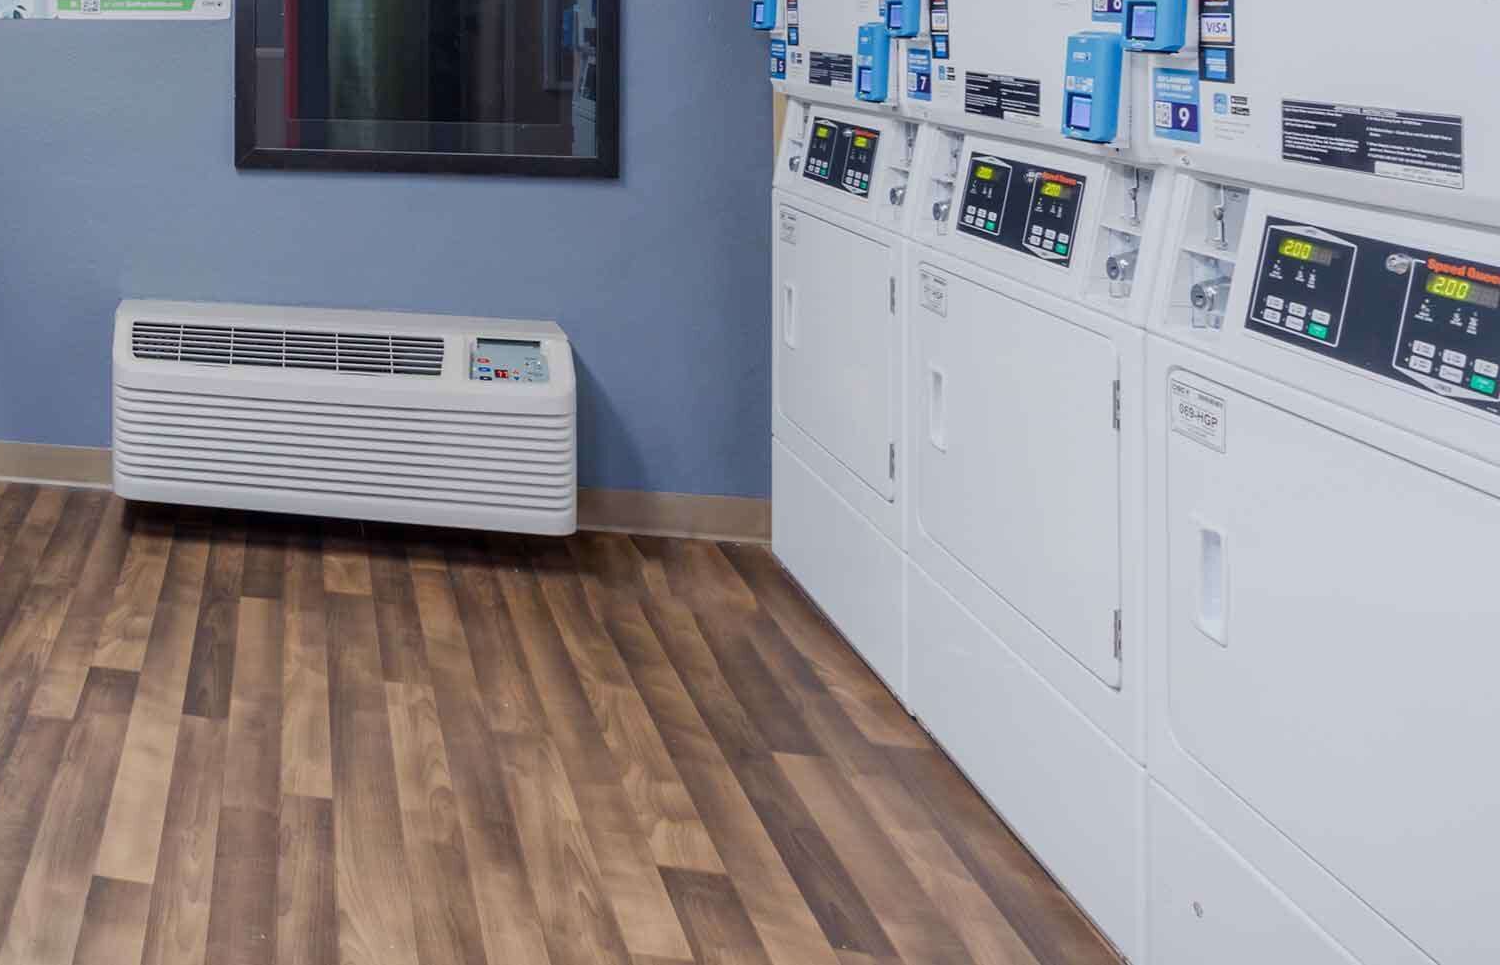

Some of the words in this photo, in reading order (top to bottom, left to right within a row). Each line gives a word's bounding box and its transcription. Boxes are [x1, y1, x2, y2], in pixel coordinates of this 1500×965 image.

[1205, 21, 1228, 33] VISA
[919, 76, 927, 90] 7
[1178, 108, 1190, 127] 9
[1427, 257, 1466, 277] Speed
